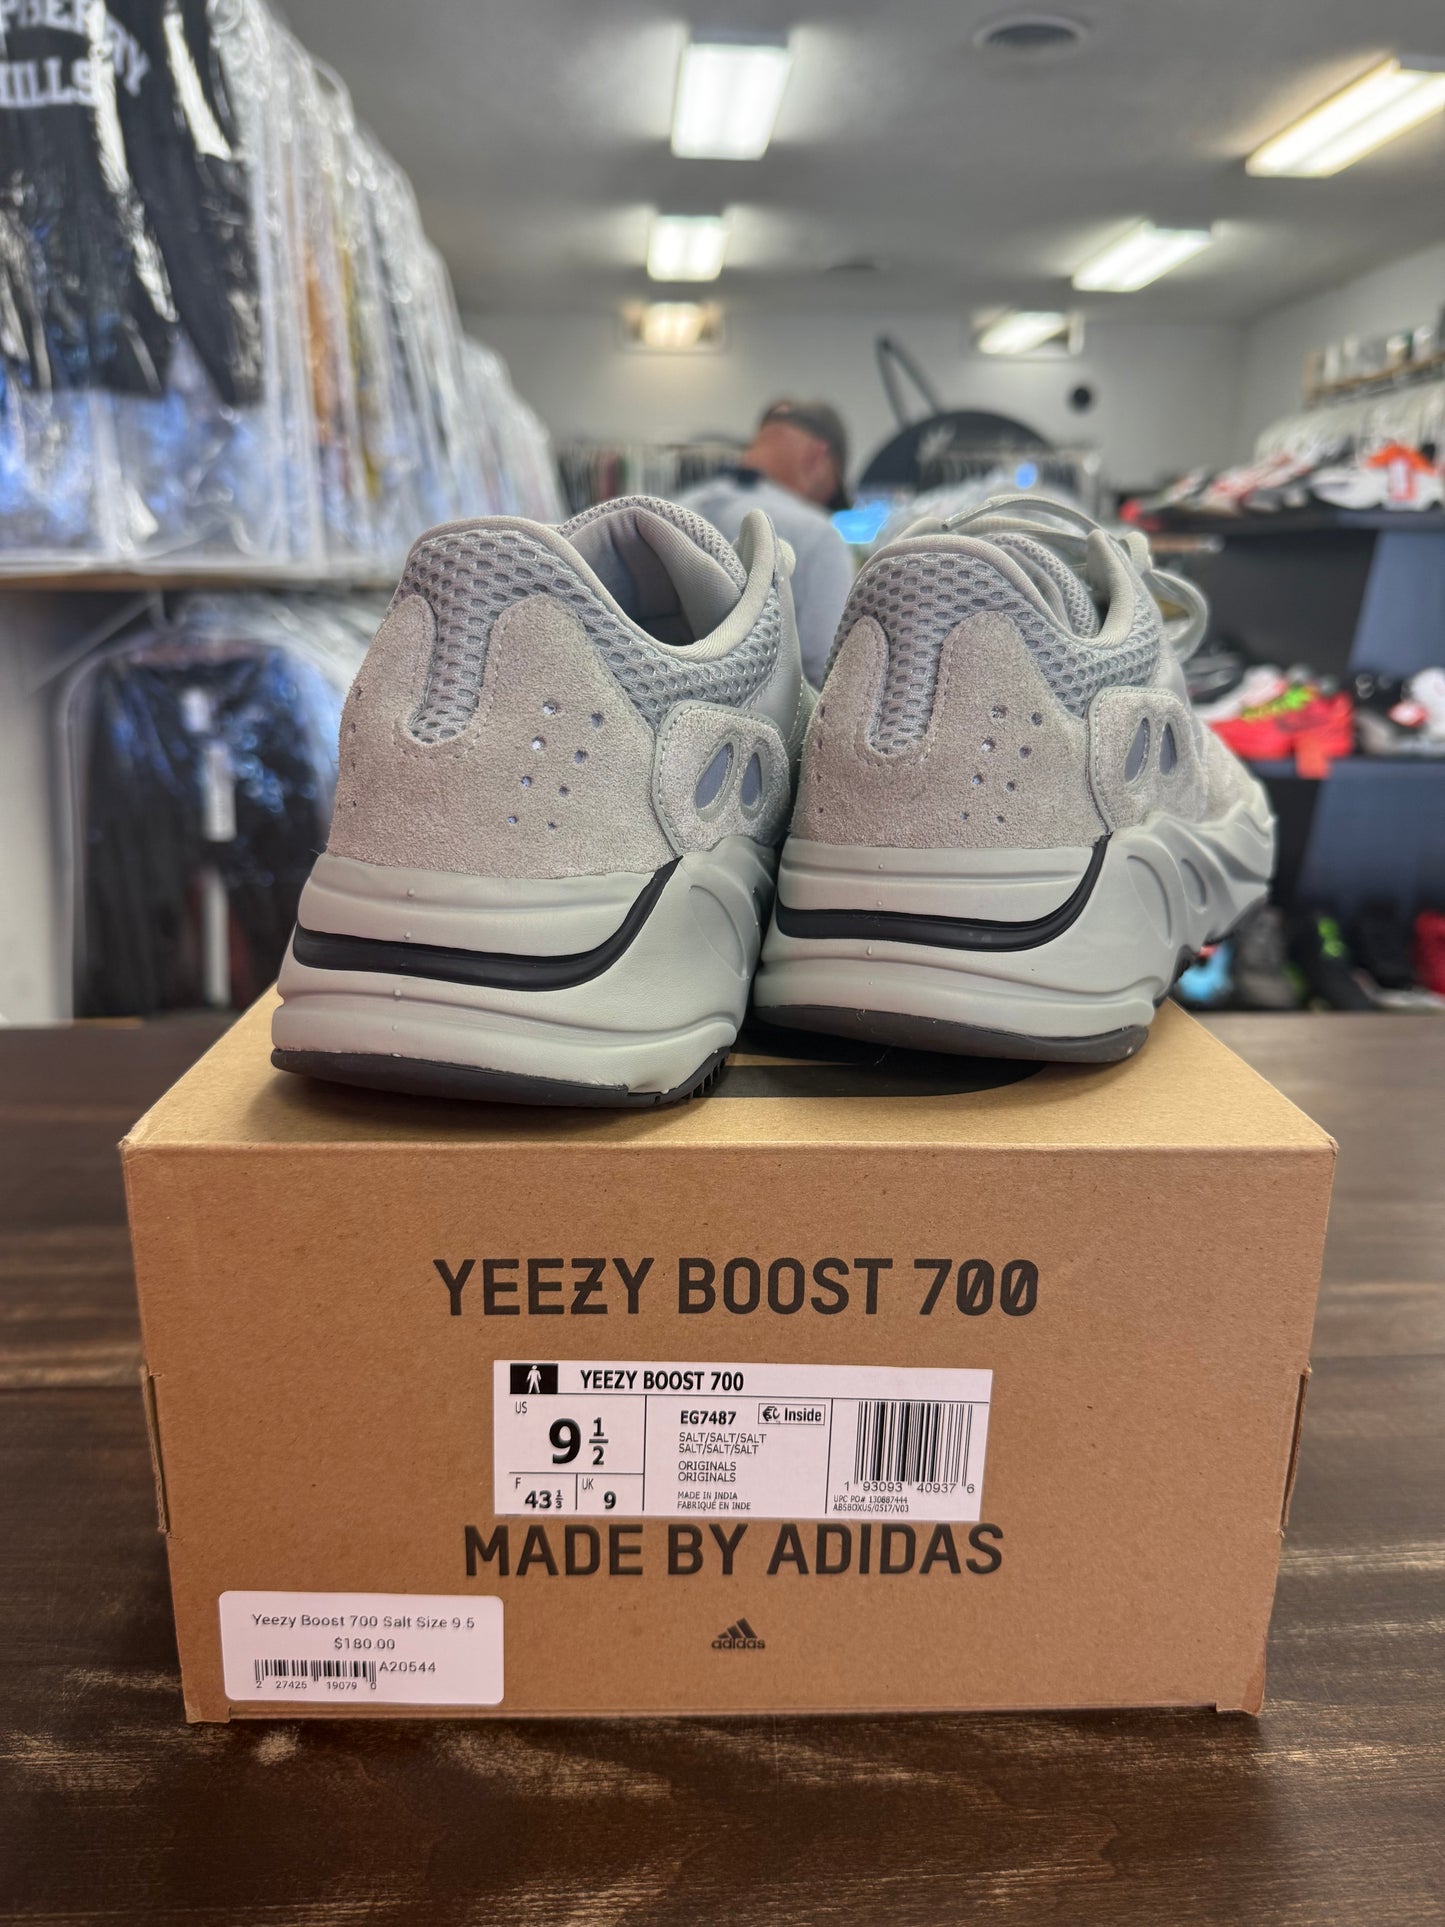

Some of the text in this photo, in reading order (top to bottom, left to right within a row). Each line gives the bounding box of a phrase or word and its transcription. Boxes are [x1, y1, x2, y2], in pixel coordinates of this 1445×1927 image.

[433, 1257, 1039, 1316] YEEZY BOOST 700
[580, 1369, 744, 1391] YEEZY BOOST 700
[515, 1401, 528, 1414] US
[680, 1410, 737, 1425] EG7487
[784, 1407, 822, 1422] Inside
[549, 1418, 581, 1464] 9
[679, 1432, 767, 1444] SALT/SALT/SALT
[678, 1443, 759, 1455] SALT/SALT/SALT
[678, 1461, 737, 1471] ORIGINALS
[515, 1478, 521, 1489] F
[678, 1472, 736, 1483] ORIGINALS
[582, 1478, 594, 1490] UK
[844, 1481, 975, 1494] 1 93093 40937 6
[524, 1491, 552, 1509] 43
[603, 1491, 616, 1509] 9
[677, 1491, 700, 1499] MADE
[715, 1492, 738, 1500] INDIA
[833, 1495, 848, 1503] UPC
[850, 1495, 866, 1503] PO#
[732, 1502, 751, 1510] INDE
[465, 1524, 1004, 1576] MADE BY ADIDAS
[252, 1614, 297, 1628] Yeezy
[301, 1615, 345, 1627] Boost
[350, 1616, 378, 1627] 700
[384, 1616, 412, 1627] Salt
[417, 1617, 447, 1628] Size
[334, 1637, 396, 1650] $180.00
[711, 1637, 766, 1649] adidas
[379, 1661, 436, 1672] A20544
[256, 1681, 262, 1689] 2
[275, 1681, 307, 1689] 27425
[327, 1681, 357, 1690] 19079
